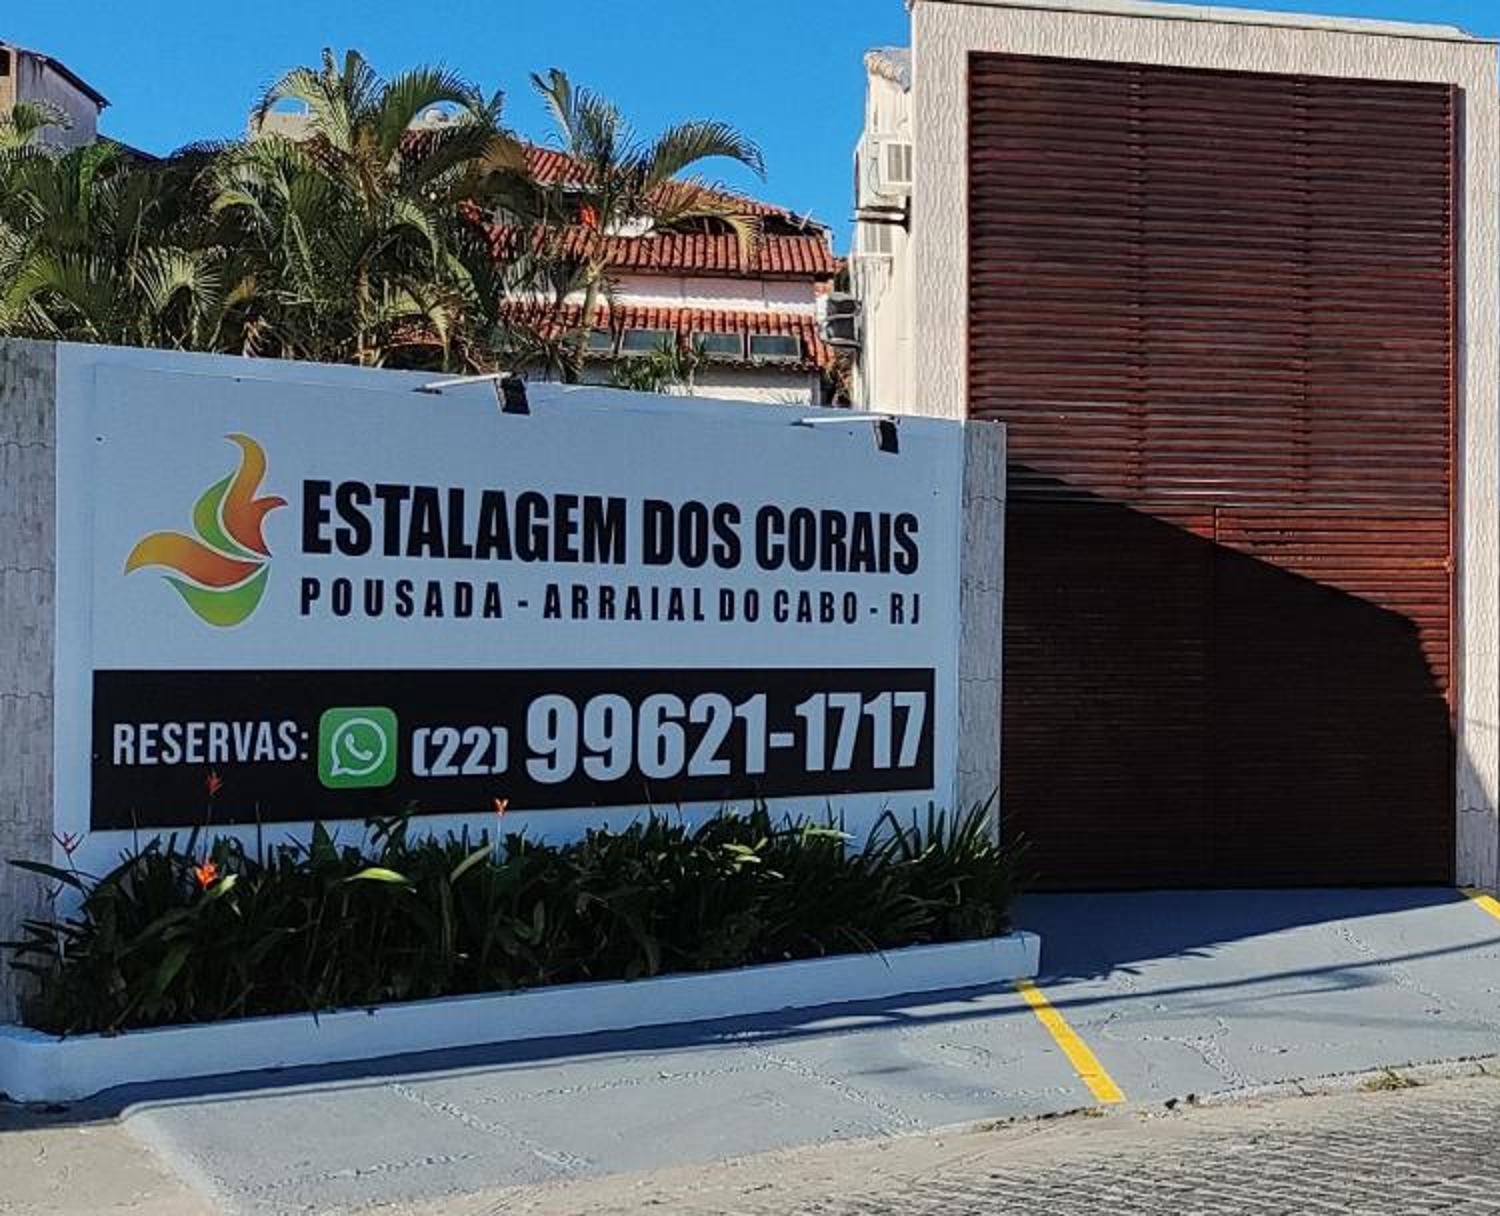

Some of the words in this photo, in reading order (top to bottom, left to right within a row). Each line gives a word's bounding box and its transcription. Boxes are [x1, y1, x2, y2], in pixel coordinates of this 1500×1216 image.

[302, 479, 627, 565] ESTALAGEM
[643, 499, 741, 569] DOS
[755, 505, 919, 575] CORAIS
[301, 577, 503, 618] POUSADA
[543, 583, 705, 622] ARRAIAL
[719, 588, 759, 623] DO
[773, 589, 858, 625] CABO
[890, 593, 920, 624] RJ
[112, 720, 309, 766] RESERVAS:
[411, 725, 510, 777] (22)
[525, 691, 928, 784] 99621-1717
